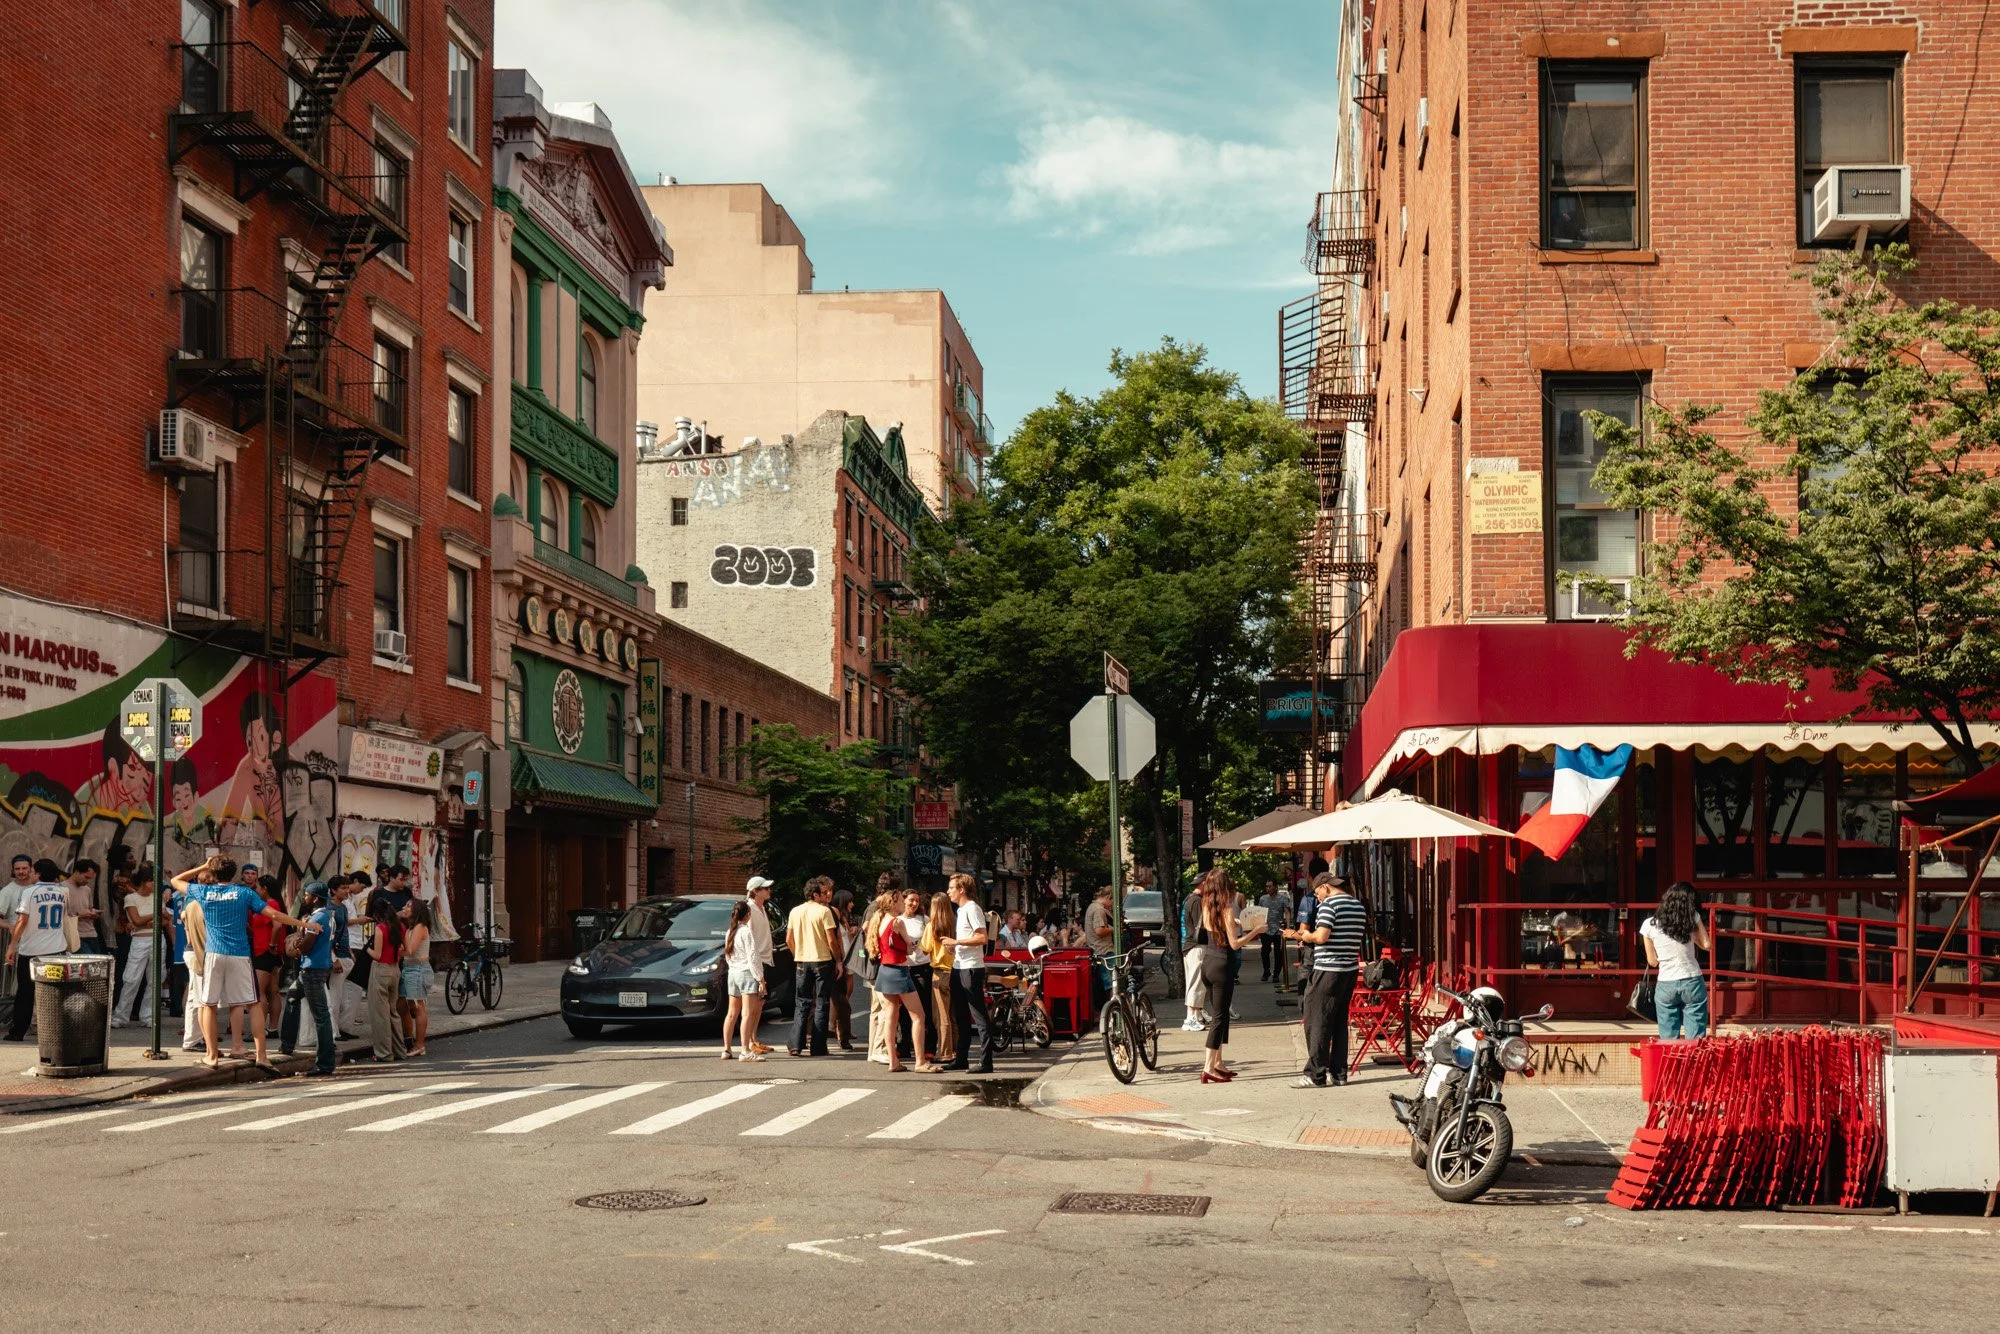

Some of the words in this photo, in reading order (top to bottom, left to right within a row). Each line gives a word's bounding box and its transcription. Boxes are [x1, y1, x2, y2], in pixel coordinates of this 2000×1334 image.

[1483, 485, 1529, 497] OLYMPIC
[1484, 518, 1539, 530] 256-3509
[14, 634, 100, 673] MARQUIS
[5, 665, 20, 680] NEW
[22, 669, 43, 686] YORK,
[44, 673, 54, 687] NY
[56, 676, 77, 691] 10002
[1783, 728, 1800, 741] Le
[34, 893, 65, 904] ZIDAN
[206, 891, 239, 900] FRANCE
[38, 904, 63, 930] 10
